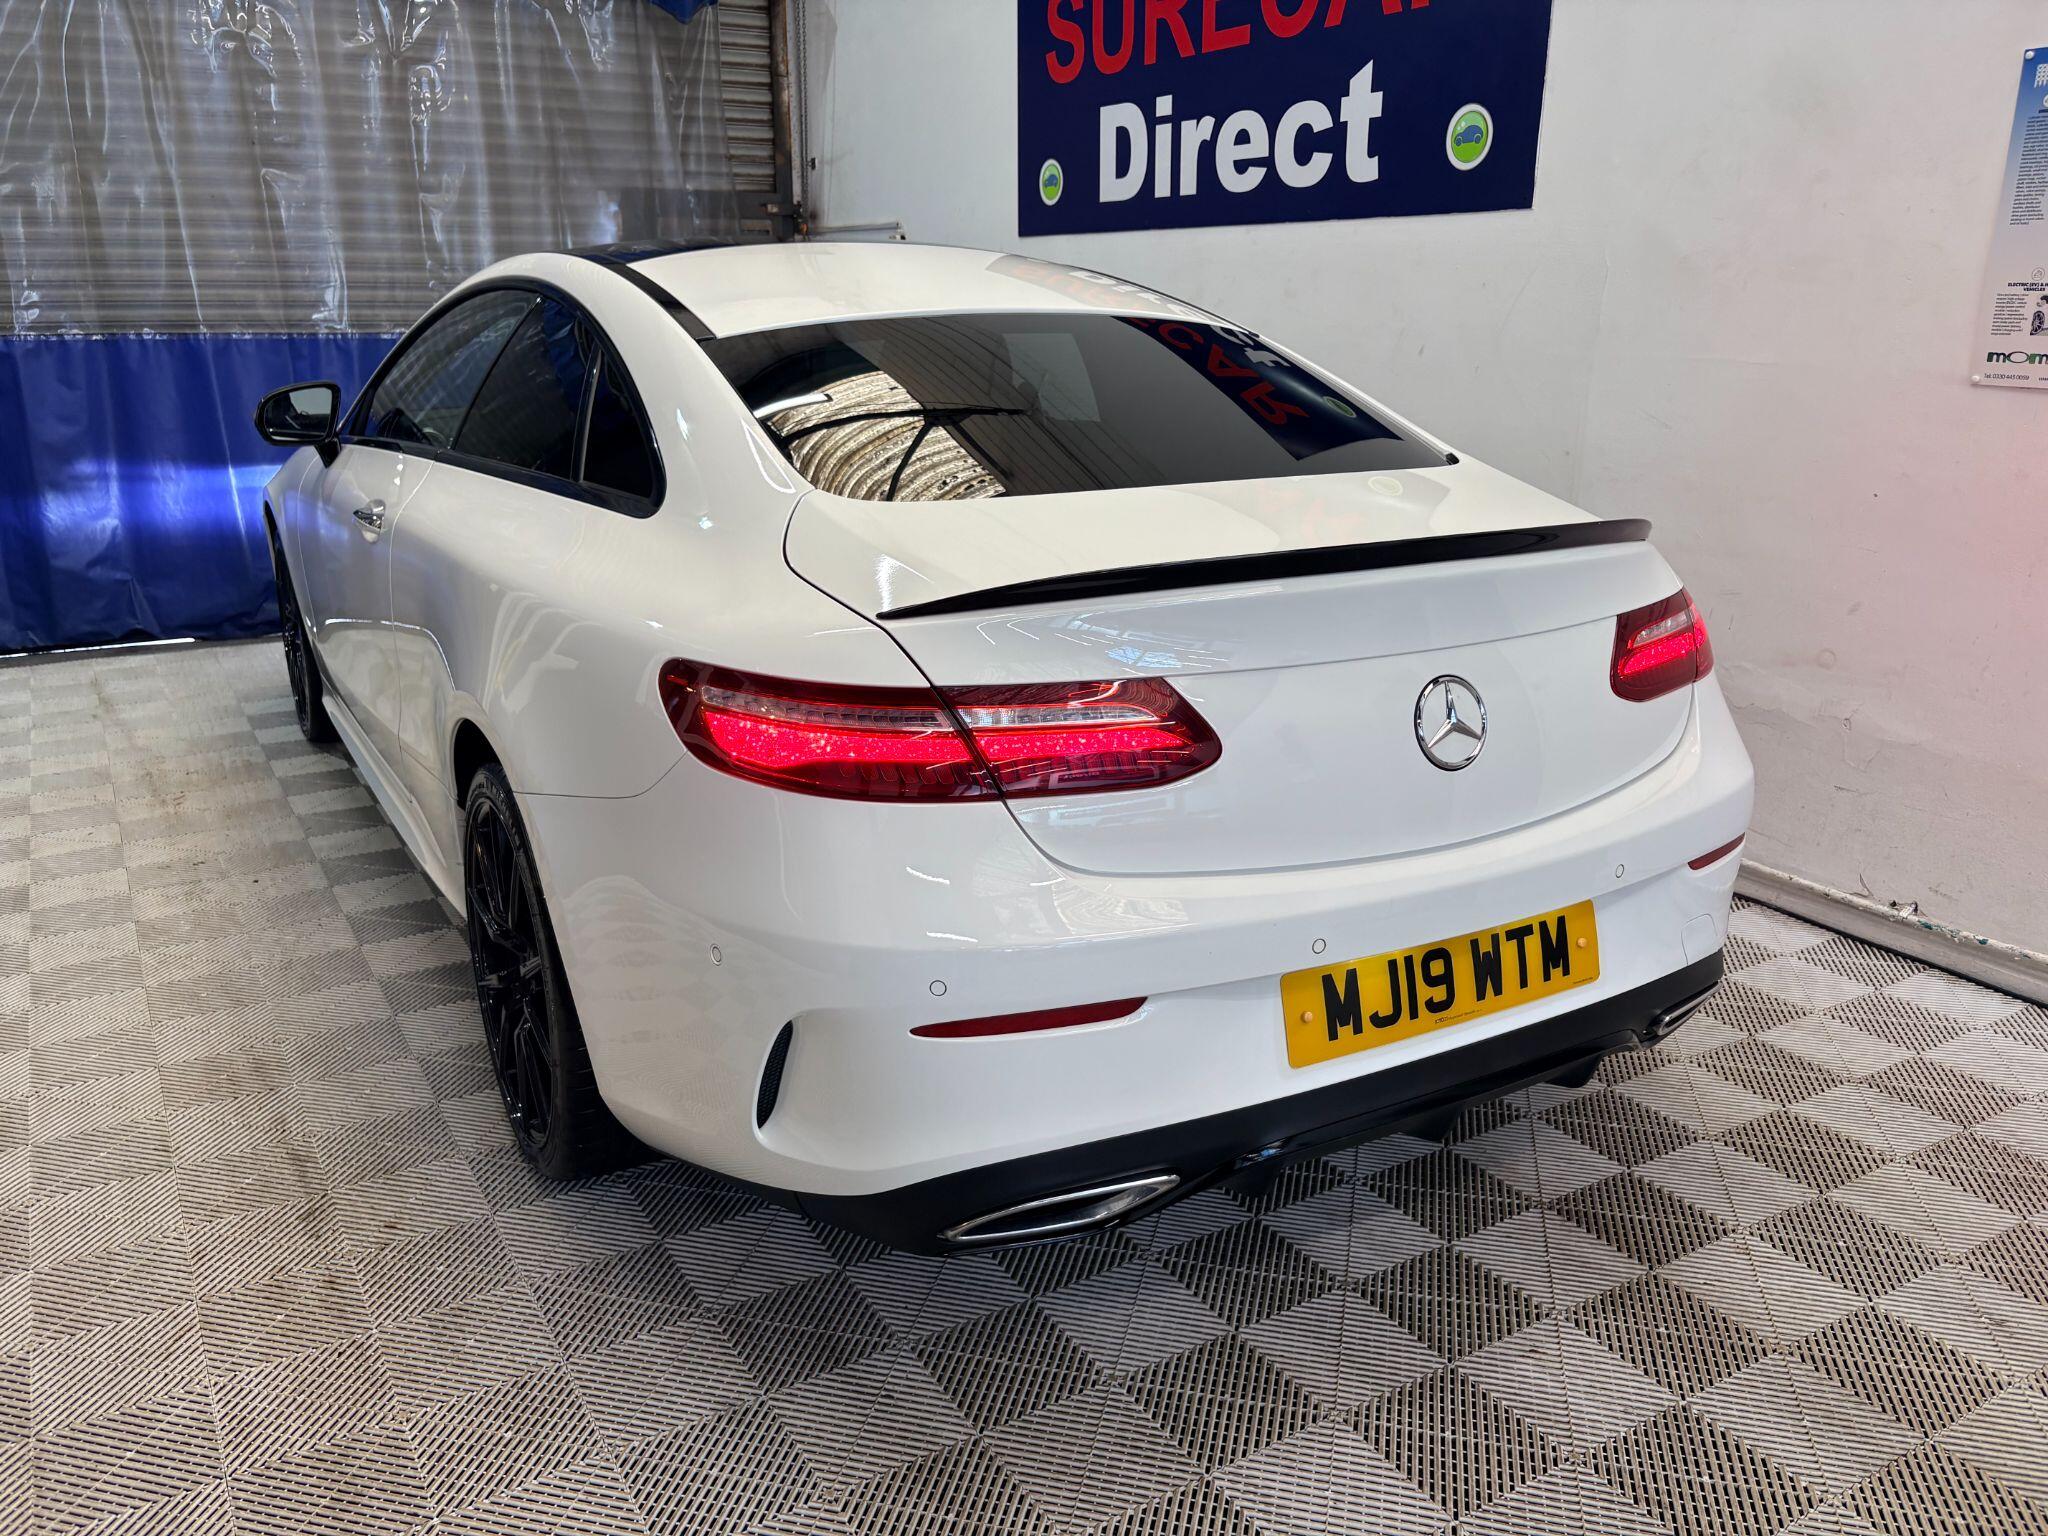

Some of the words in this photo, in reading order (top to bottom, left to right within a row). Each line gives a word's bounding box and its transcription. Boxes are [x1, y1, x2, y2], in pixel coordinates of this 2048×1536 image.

[1100, 60, 1382, 202] Direct
[1321, 947, 1455, 1041] MJ19
[1469, 915, 1570, 1001] WTM
